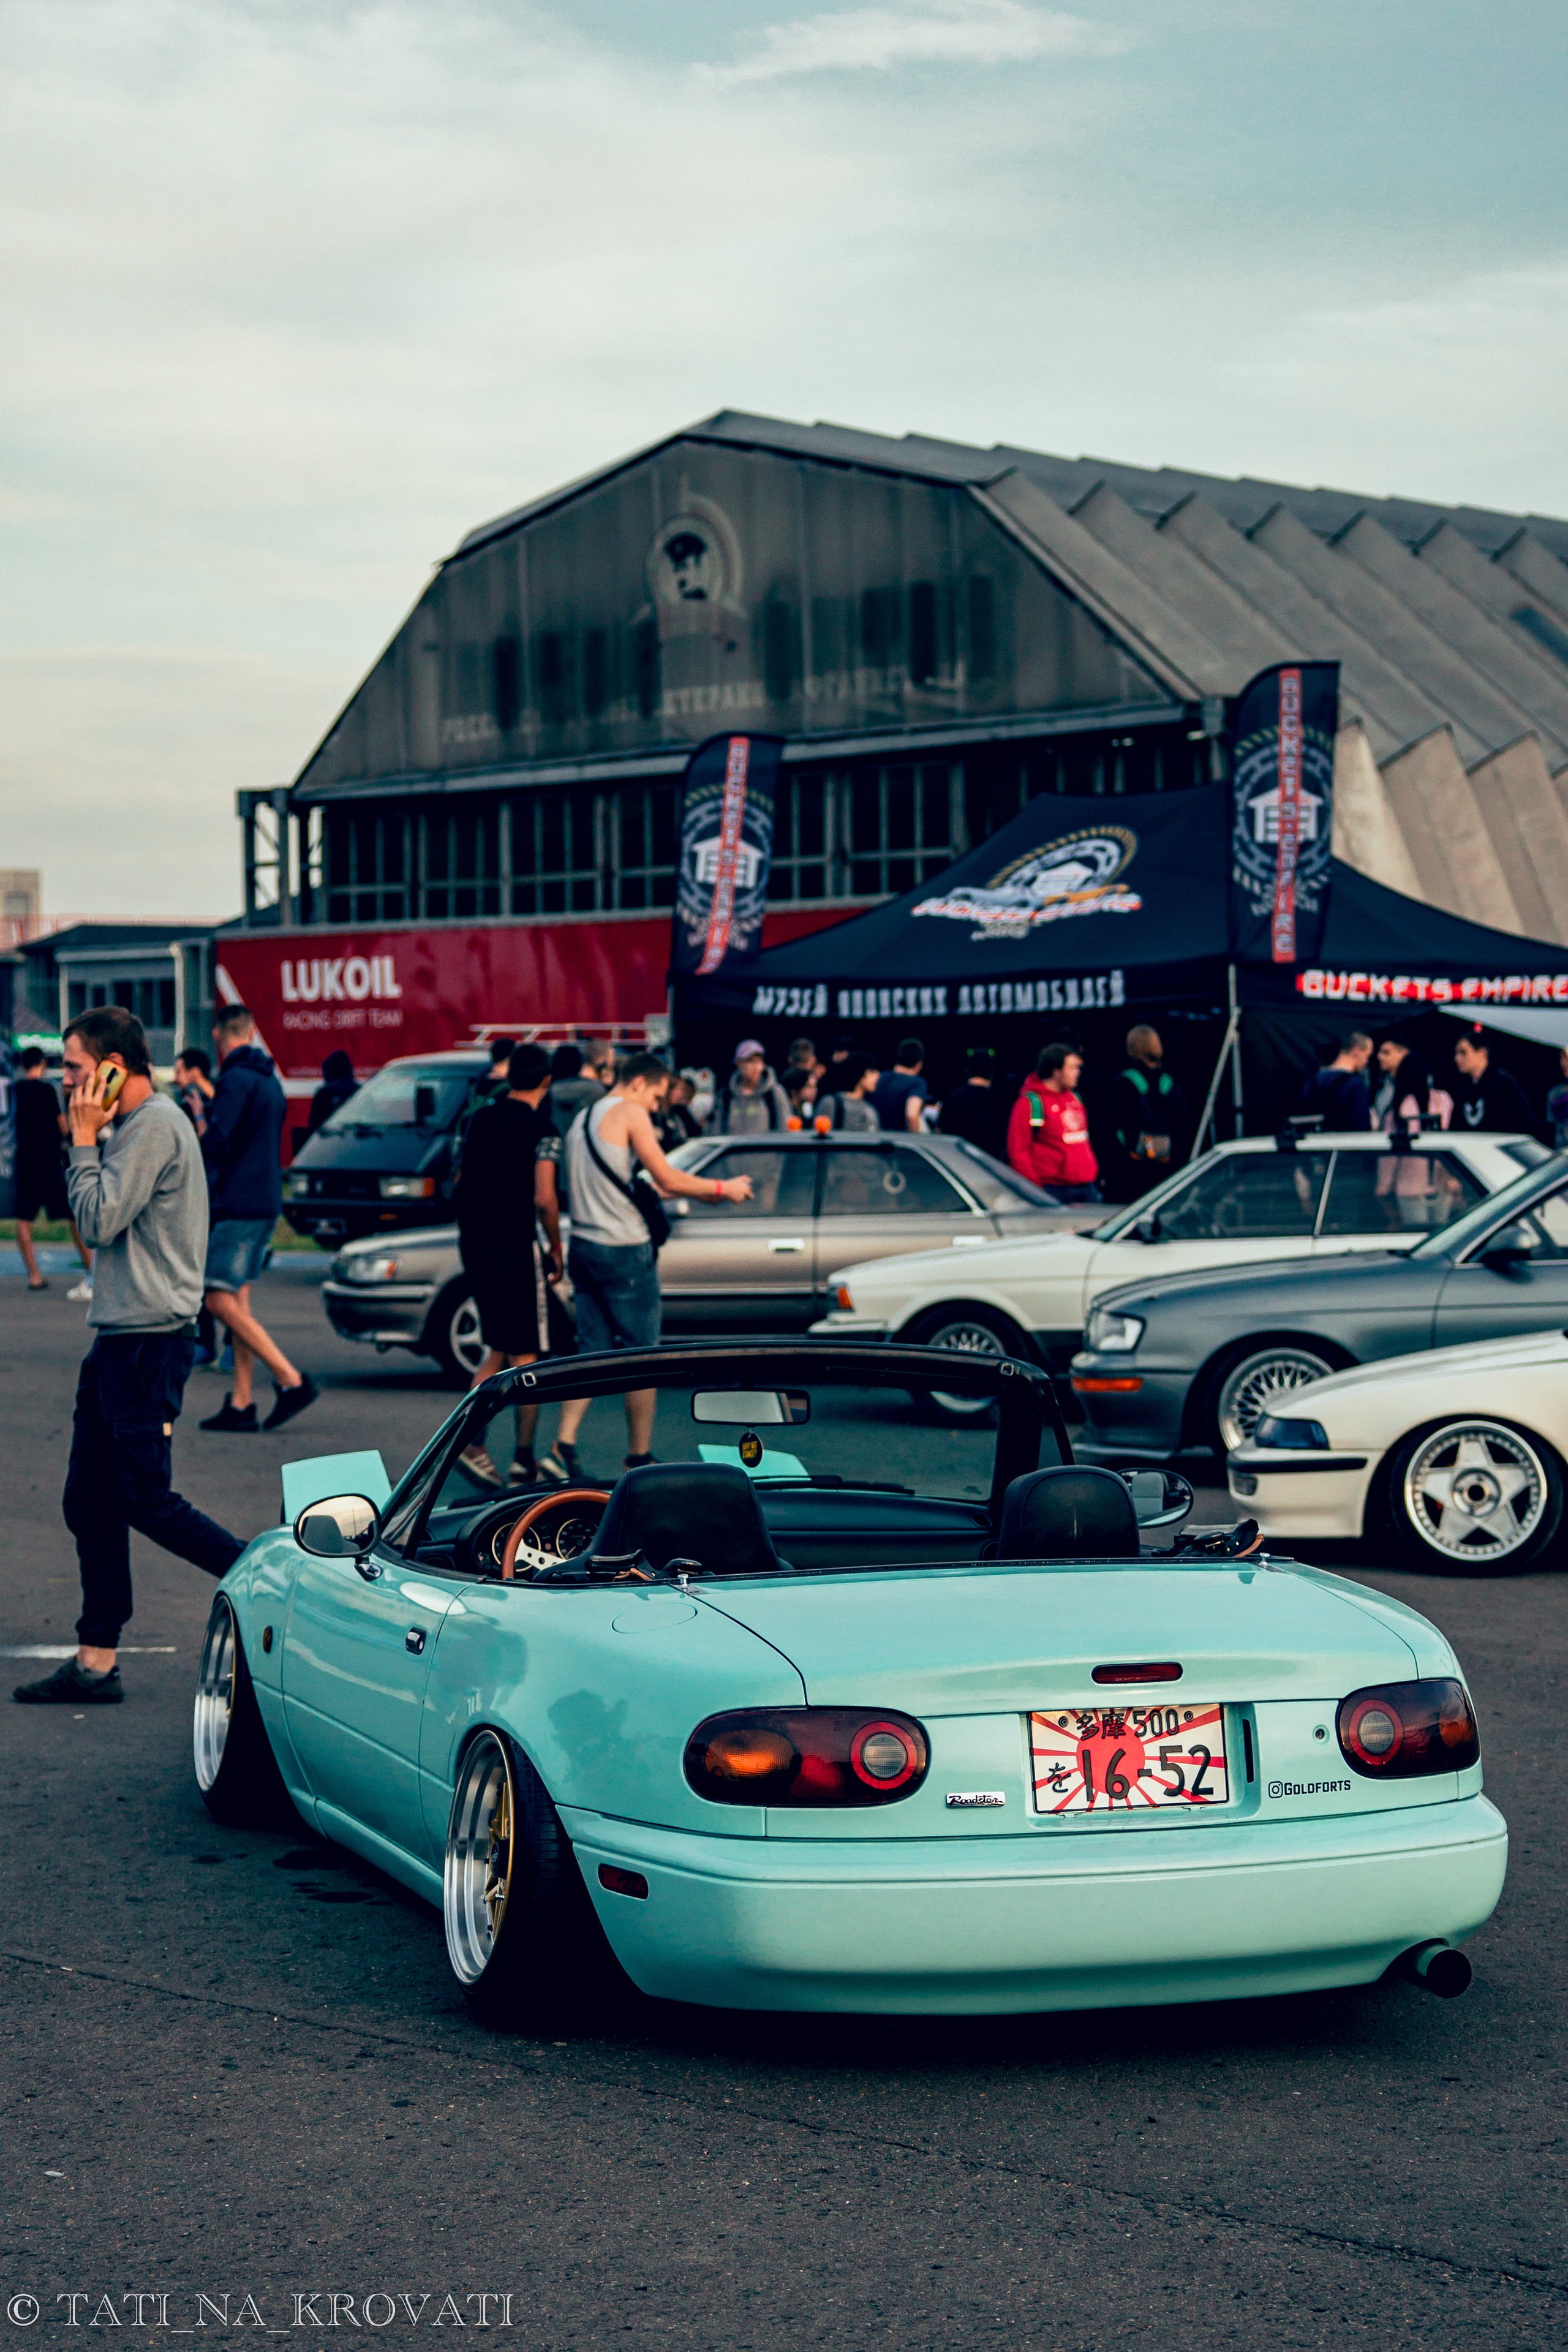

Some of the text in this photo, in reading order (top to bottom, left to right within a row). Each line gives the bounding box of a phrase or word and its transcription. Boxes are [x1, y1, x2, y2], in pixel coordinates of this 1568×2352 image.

[281, 956, 402, 1001] LUKOIL
[1303, 970, 1568, 1003] BUCKETS EMPIRE
[752, 984, 827, 1016] МУЗЕЙ
[1077, 1708, 1180, 1741] 多摩 500
[1048, 1744, 1214, 1802] を 16-52
[1284, 1780, 1351, 1795] GOLDFORTS
[949, 1795, 1004, 1806] Roadster
